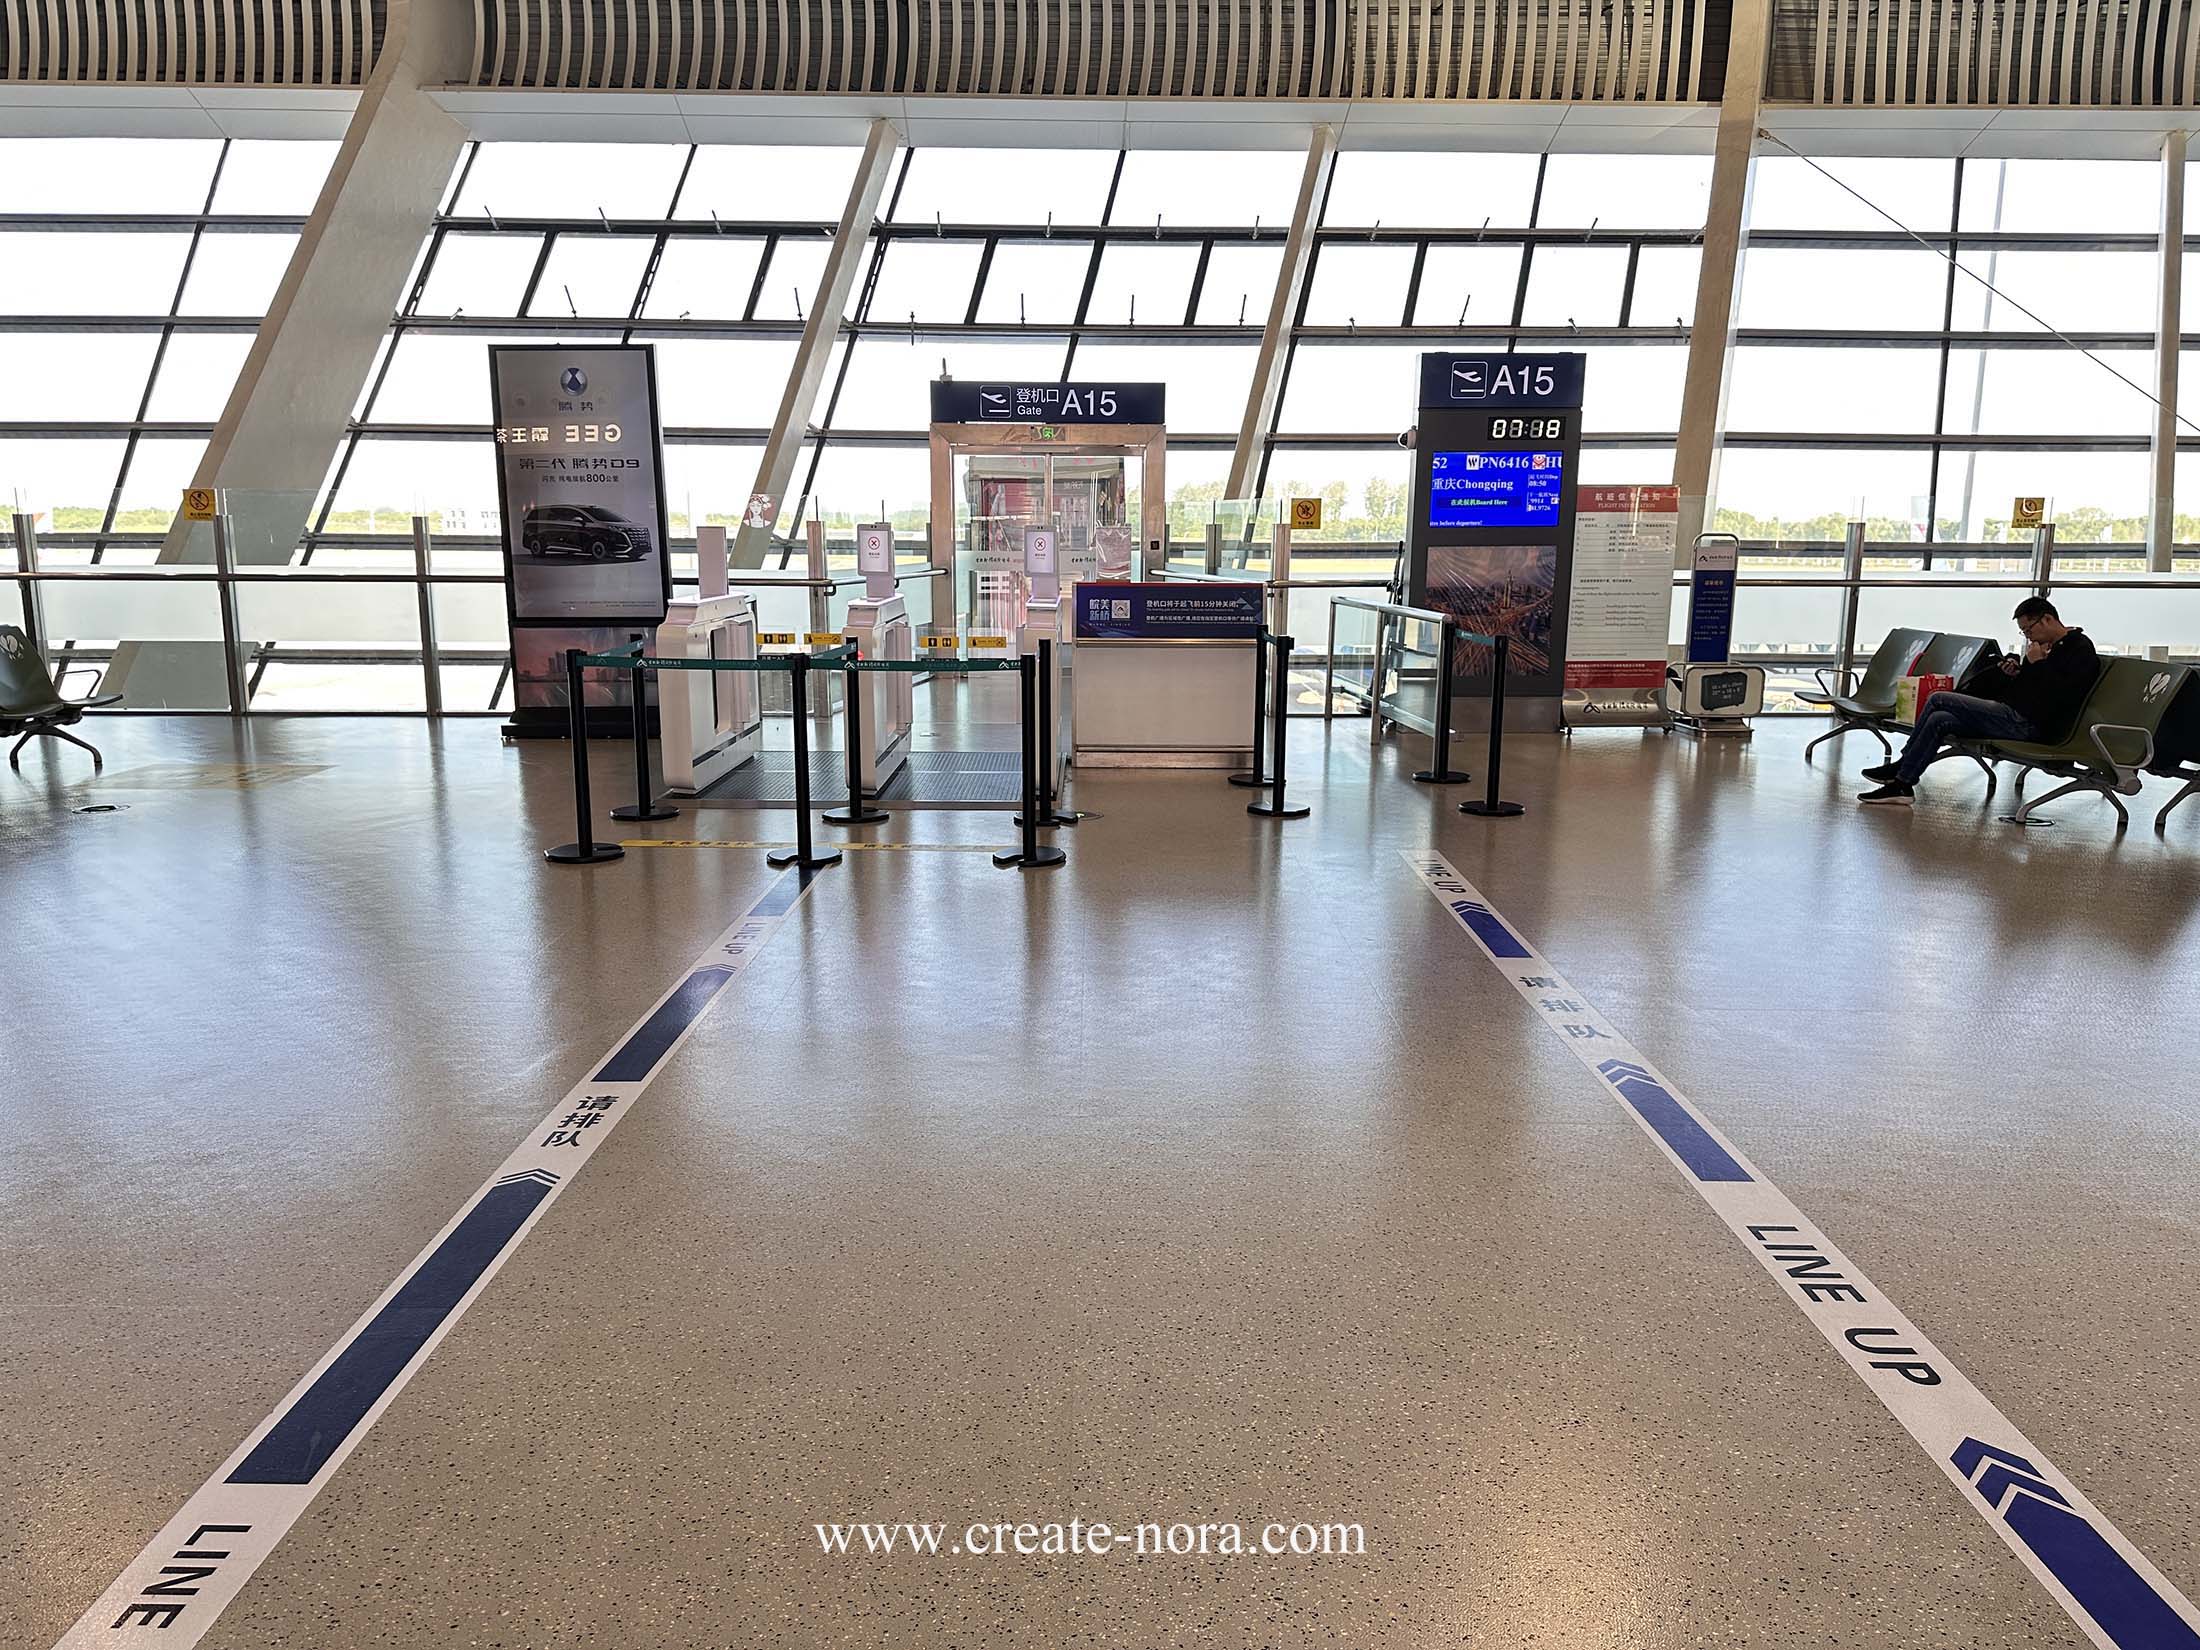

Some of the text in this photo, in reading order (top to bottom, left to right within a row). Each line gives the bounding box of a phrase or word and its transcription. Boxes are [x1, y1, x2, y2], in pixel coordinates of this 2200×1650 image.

[1490, 364, 1554, 396] A15
[1016, 388, 1059, 404] 登机口
[1061, 389, 1117, 416] A15
[1017, 405, 1042, 416] Gate
[1492, 419, 1560, 438] 07:18
[519, 458, 567, 470] 第二代
[1432, 457, 1448, 469] 52
[1480, 456, 1529, 469] PN6416
[1432, 478, 1514, 491] 重庆Chongqing
[1434, 881, 1466, 894] UP
[722, 943, 744, 955] UP
[1519, 976, 1612, 1039] 请排队
[541, 1095, 619, 1148] 请排队
[1745, 1225, 1942, 1386] LINE UP
[110, 1524, 252, 1629] LINE
